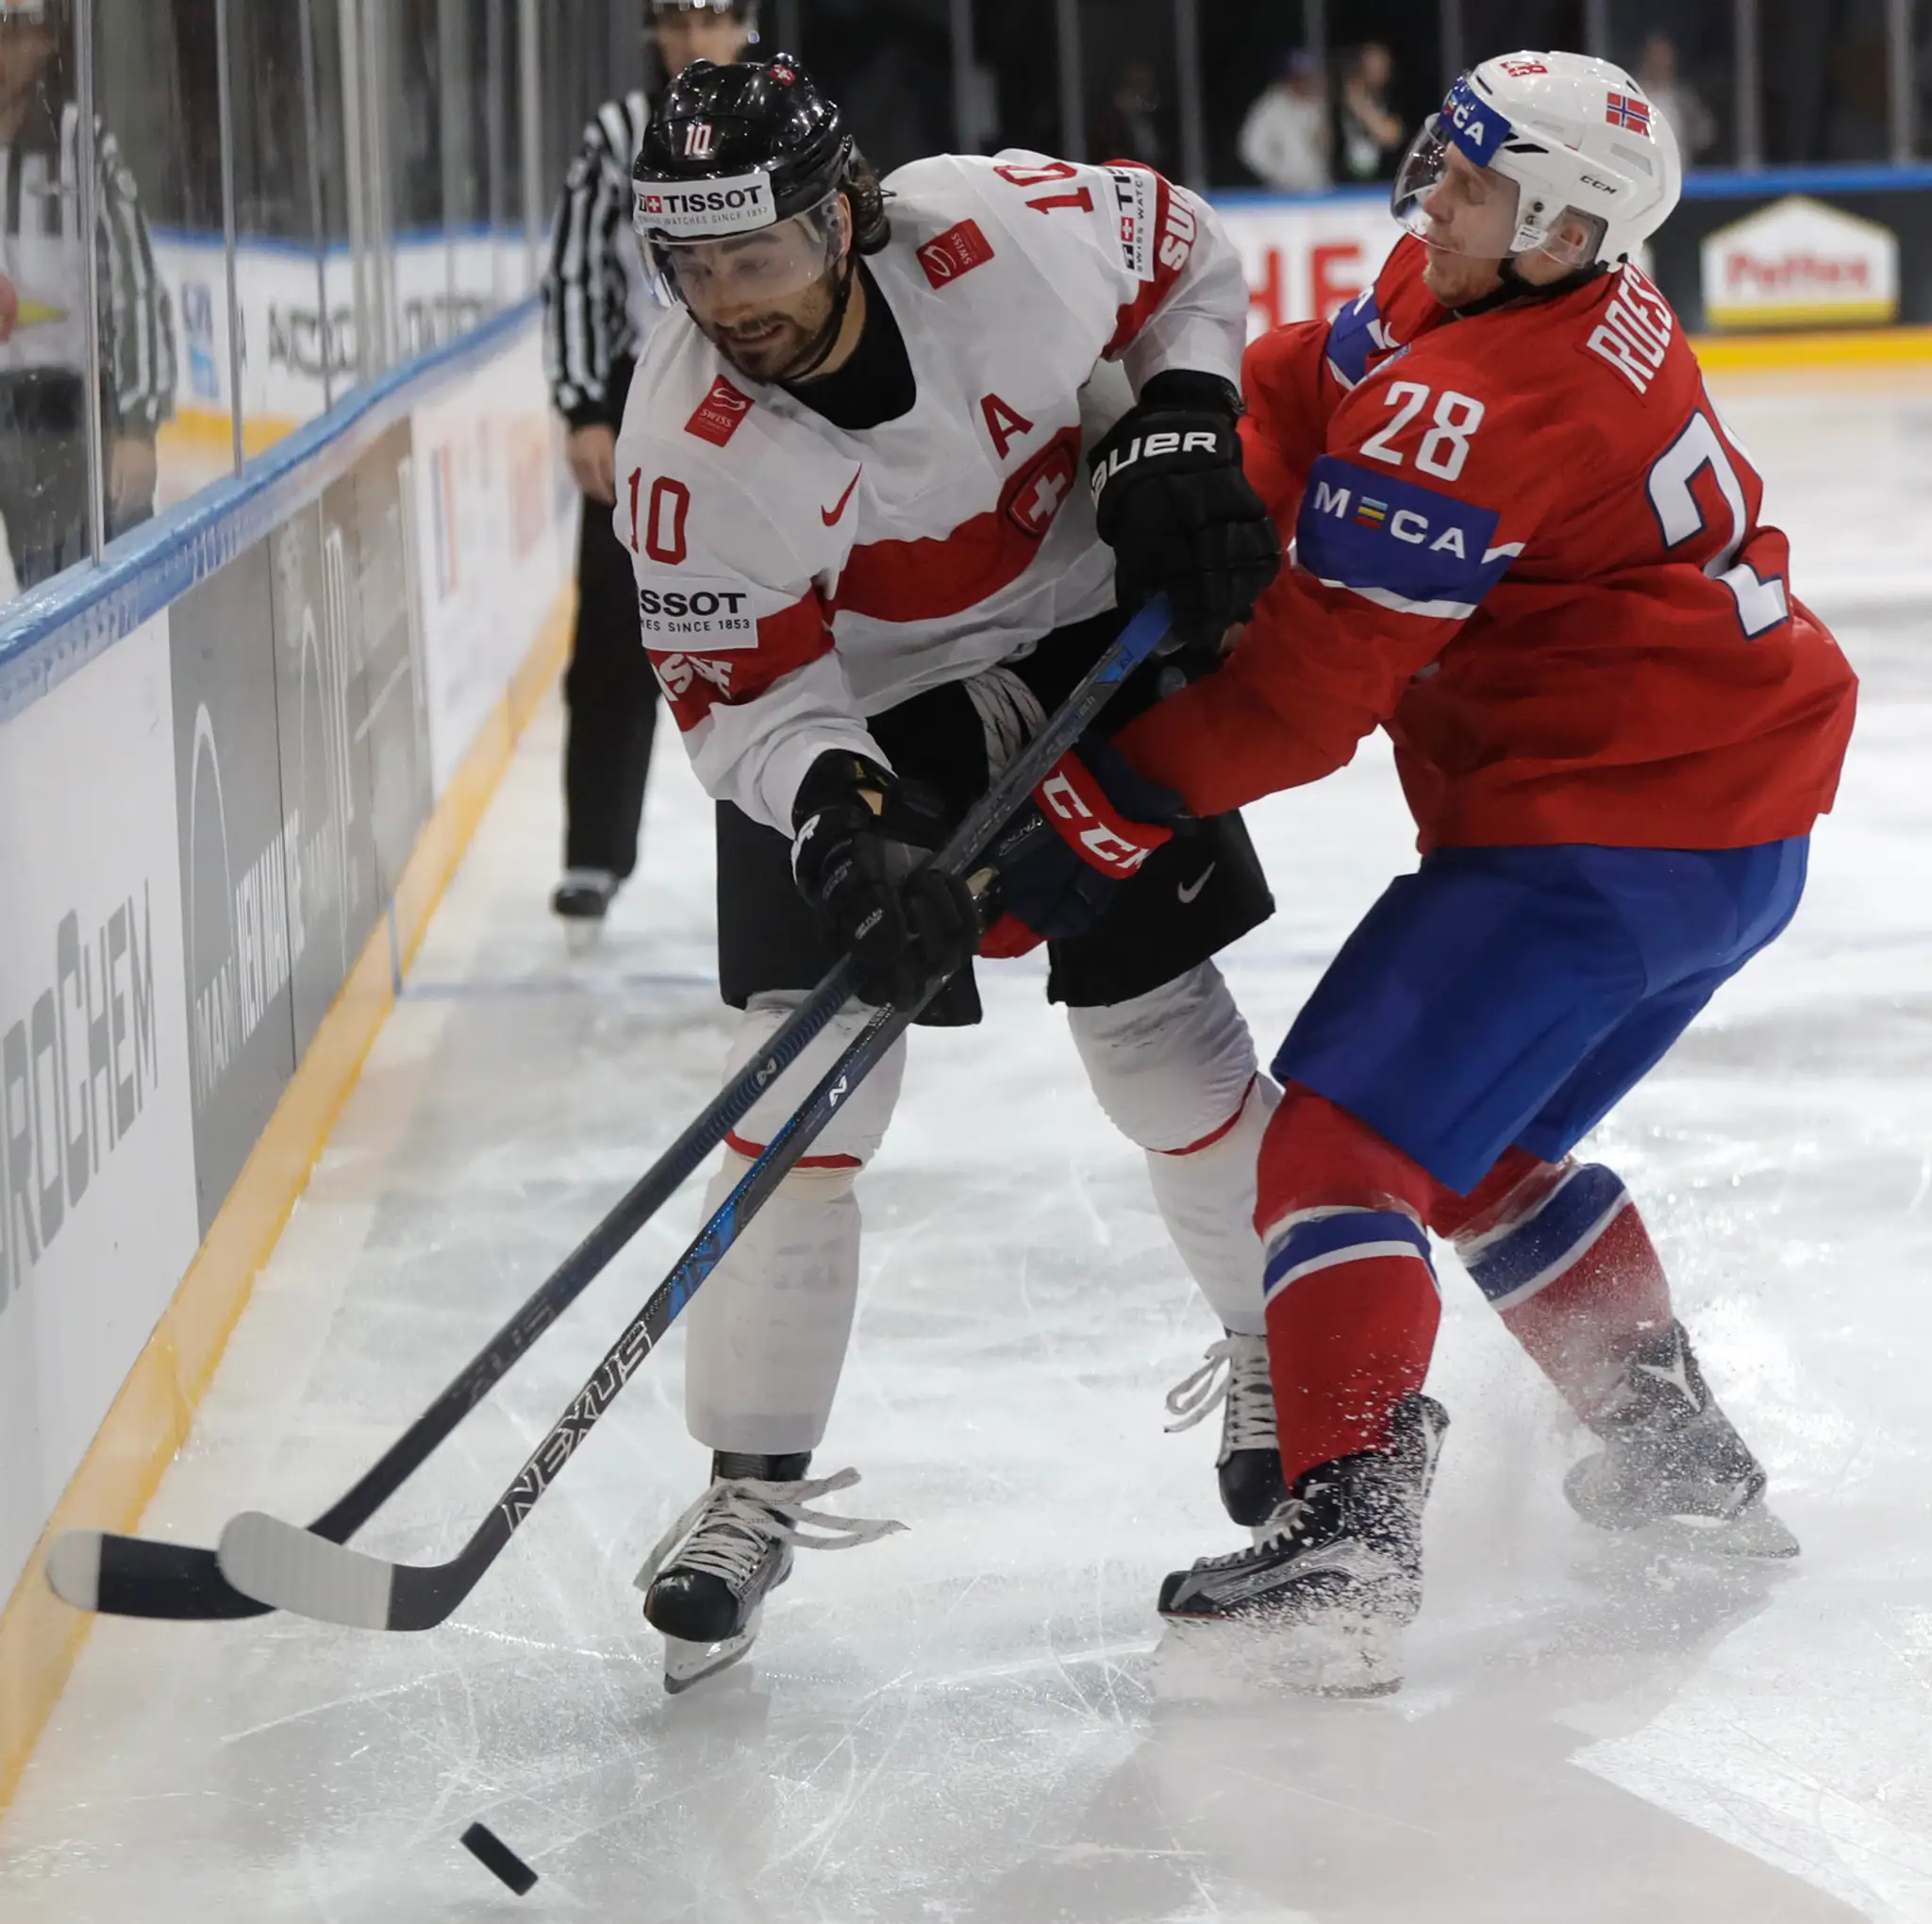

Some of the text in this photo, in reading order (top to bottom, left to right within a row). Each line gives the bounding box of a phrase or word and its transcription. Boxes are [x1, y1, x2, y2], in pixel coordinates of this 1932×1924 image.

[684, 124, 712, 157] 10
[663, 185, 762, 213] TISSOT
[993, 161, 1094, 214] 10
[1580, 176, 1617, 194] CCM
[1586, 262, 1673, 394] ROES
[700, 409, 733, 428] SWISS
[980, 393, 1035, 460] A
[1359, 380, 1485, 482] 28
[628, 466, 691, 565] 10
[668, 622, 711, 632] SINCE
[718, 618, 751, 629] 1853
[0, 877, 158, 1316] ROCHEM
[497, 1320, 654, 1537] NEXUS
